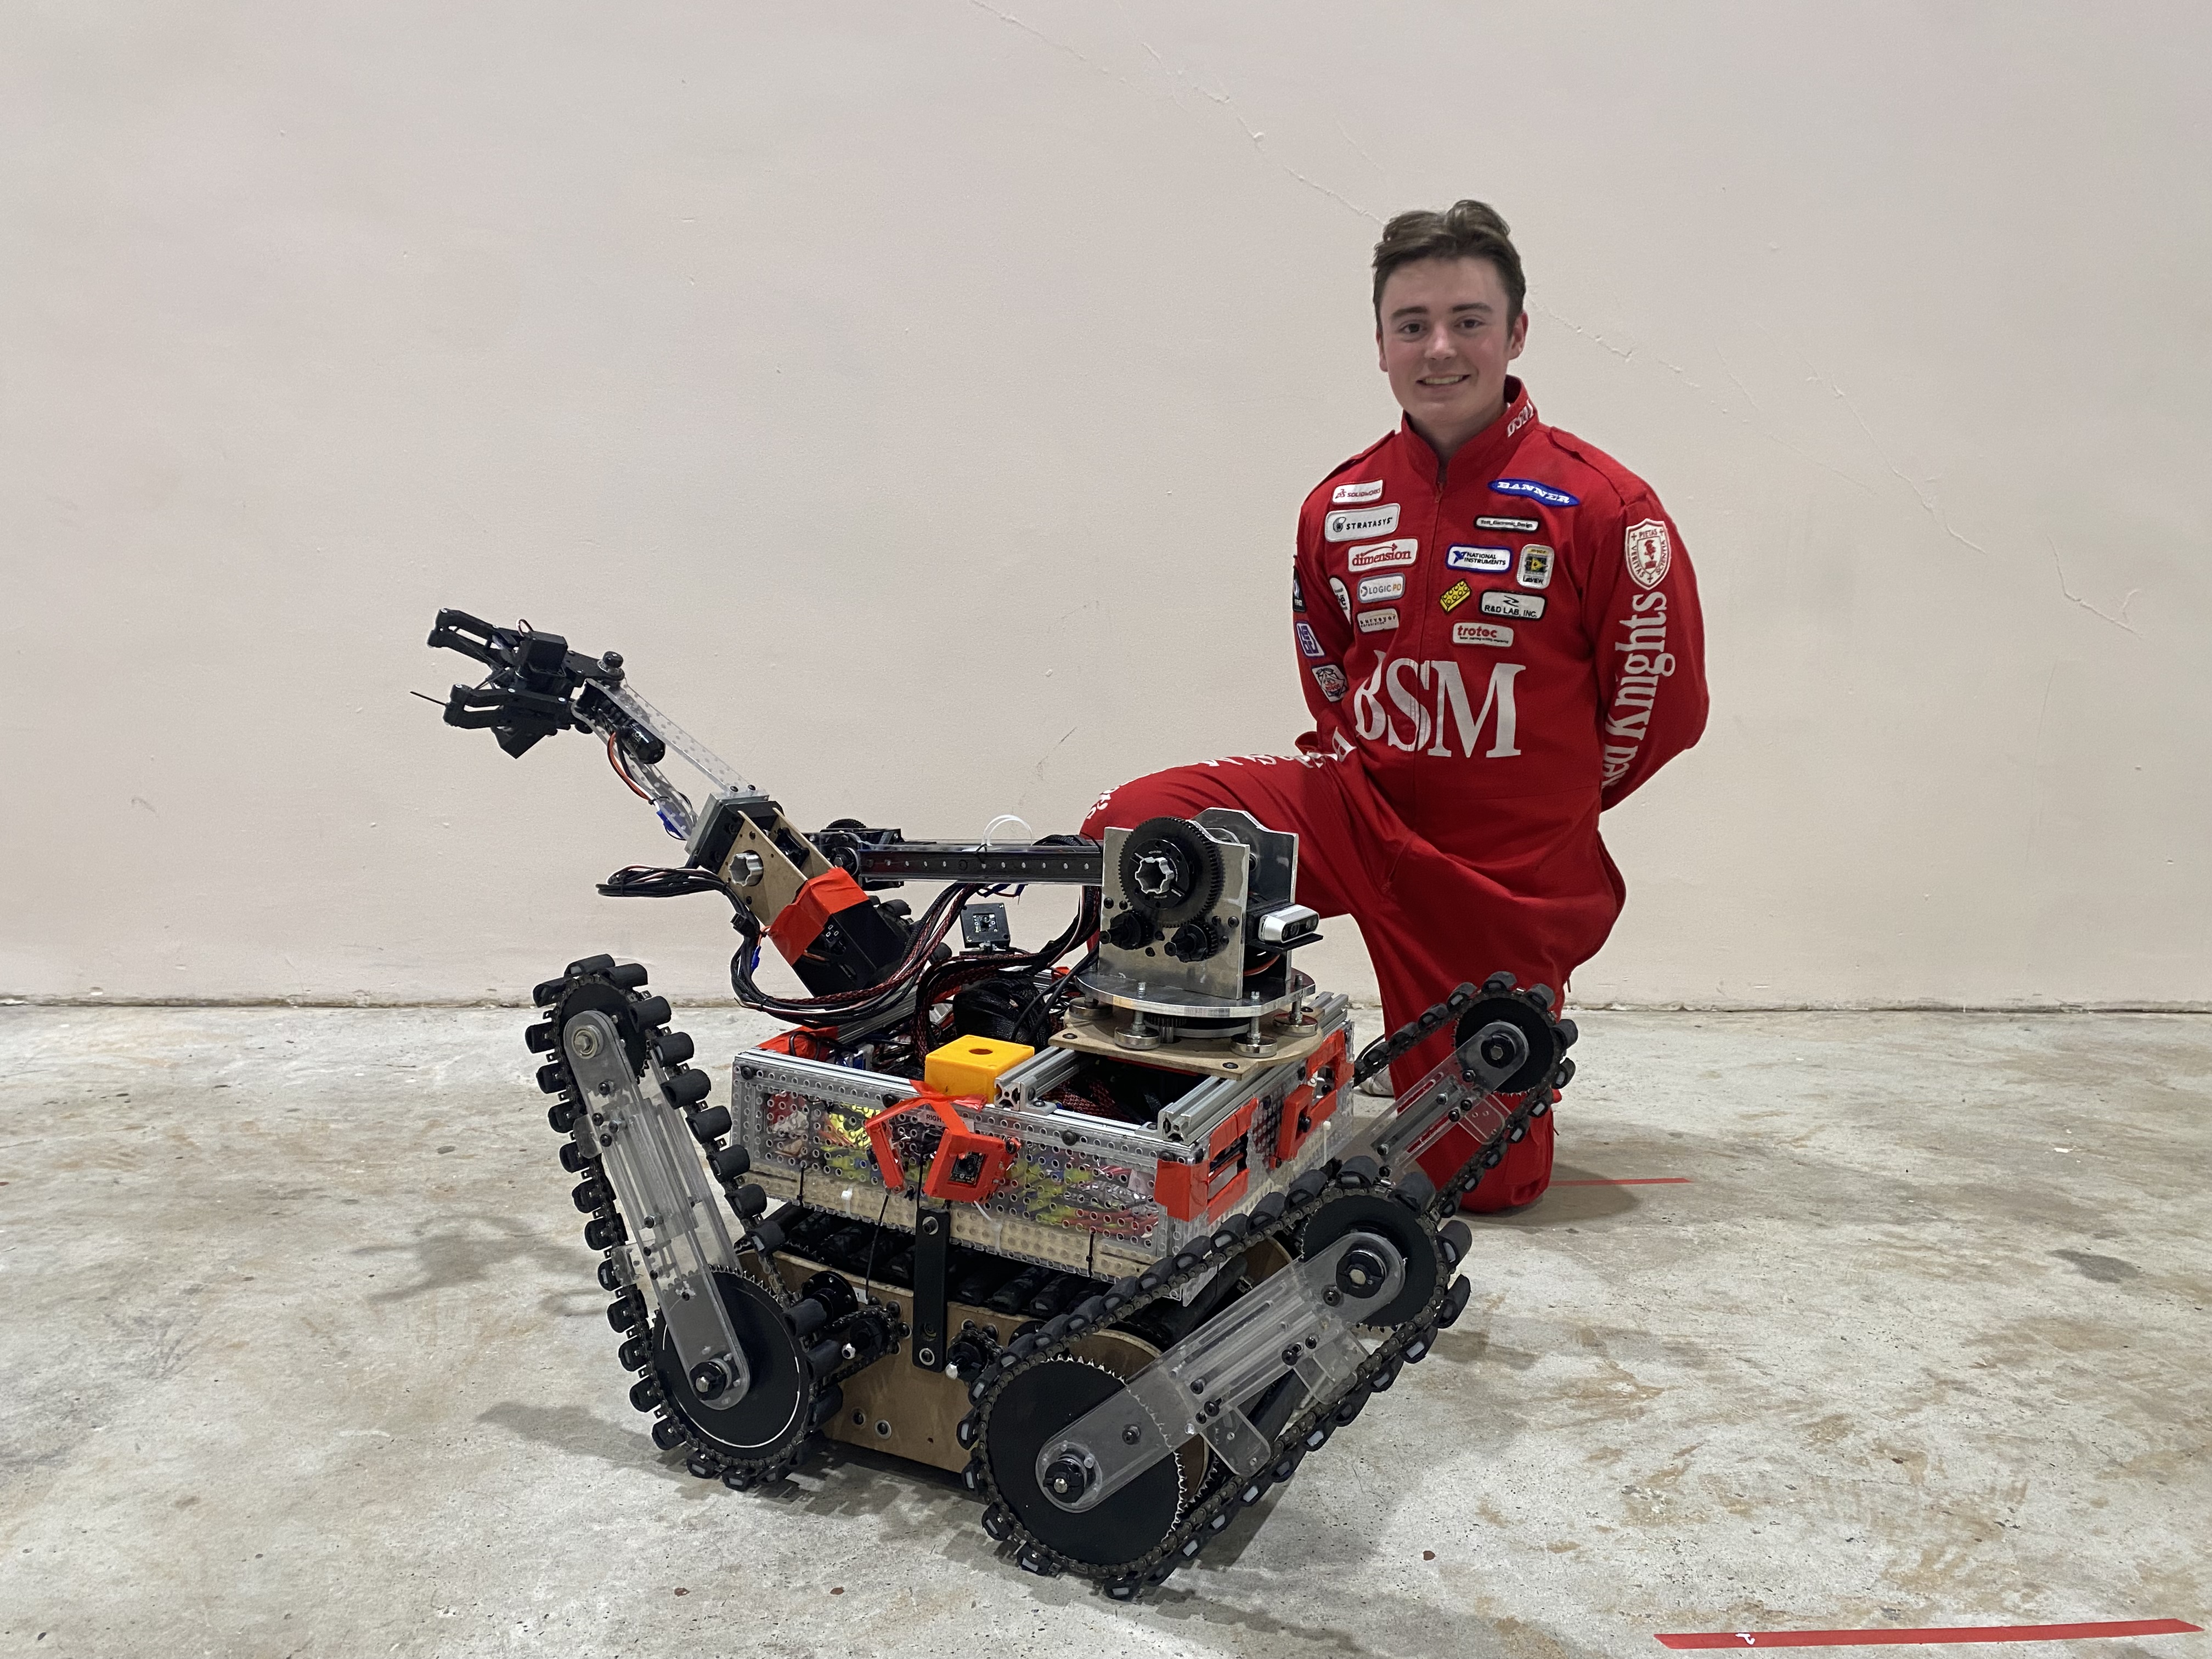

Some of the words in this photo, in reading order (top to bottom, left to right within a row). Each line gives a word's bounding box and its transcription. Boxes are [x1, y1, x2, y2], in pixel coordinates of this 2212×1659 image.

[1497, 481, 1570, 504] BANNER
[1346, 517, 1392, 530] STRATASYS
[1639, 529, 1657, 538] PIETAS
[1352, 550, 1412, 566] dimension
[1464, 557, 1506, 566] INSTRUMENTS
[1631, 545, 1645, 578] VERITAS
[1369, 585, 1391, 594] LOGIC
[1485, 605, 1502, 613] R&D
[1605, 591, 1675, 741] Knights
[926, 1114, 943, 1122] RIGH
